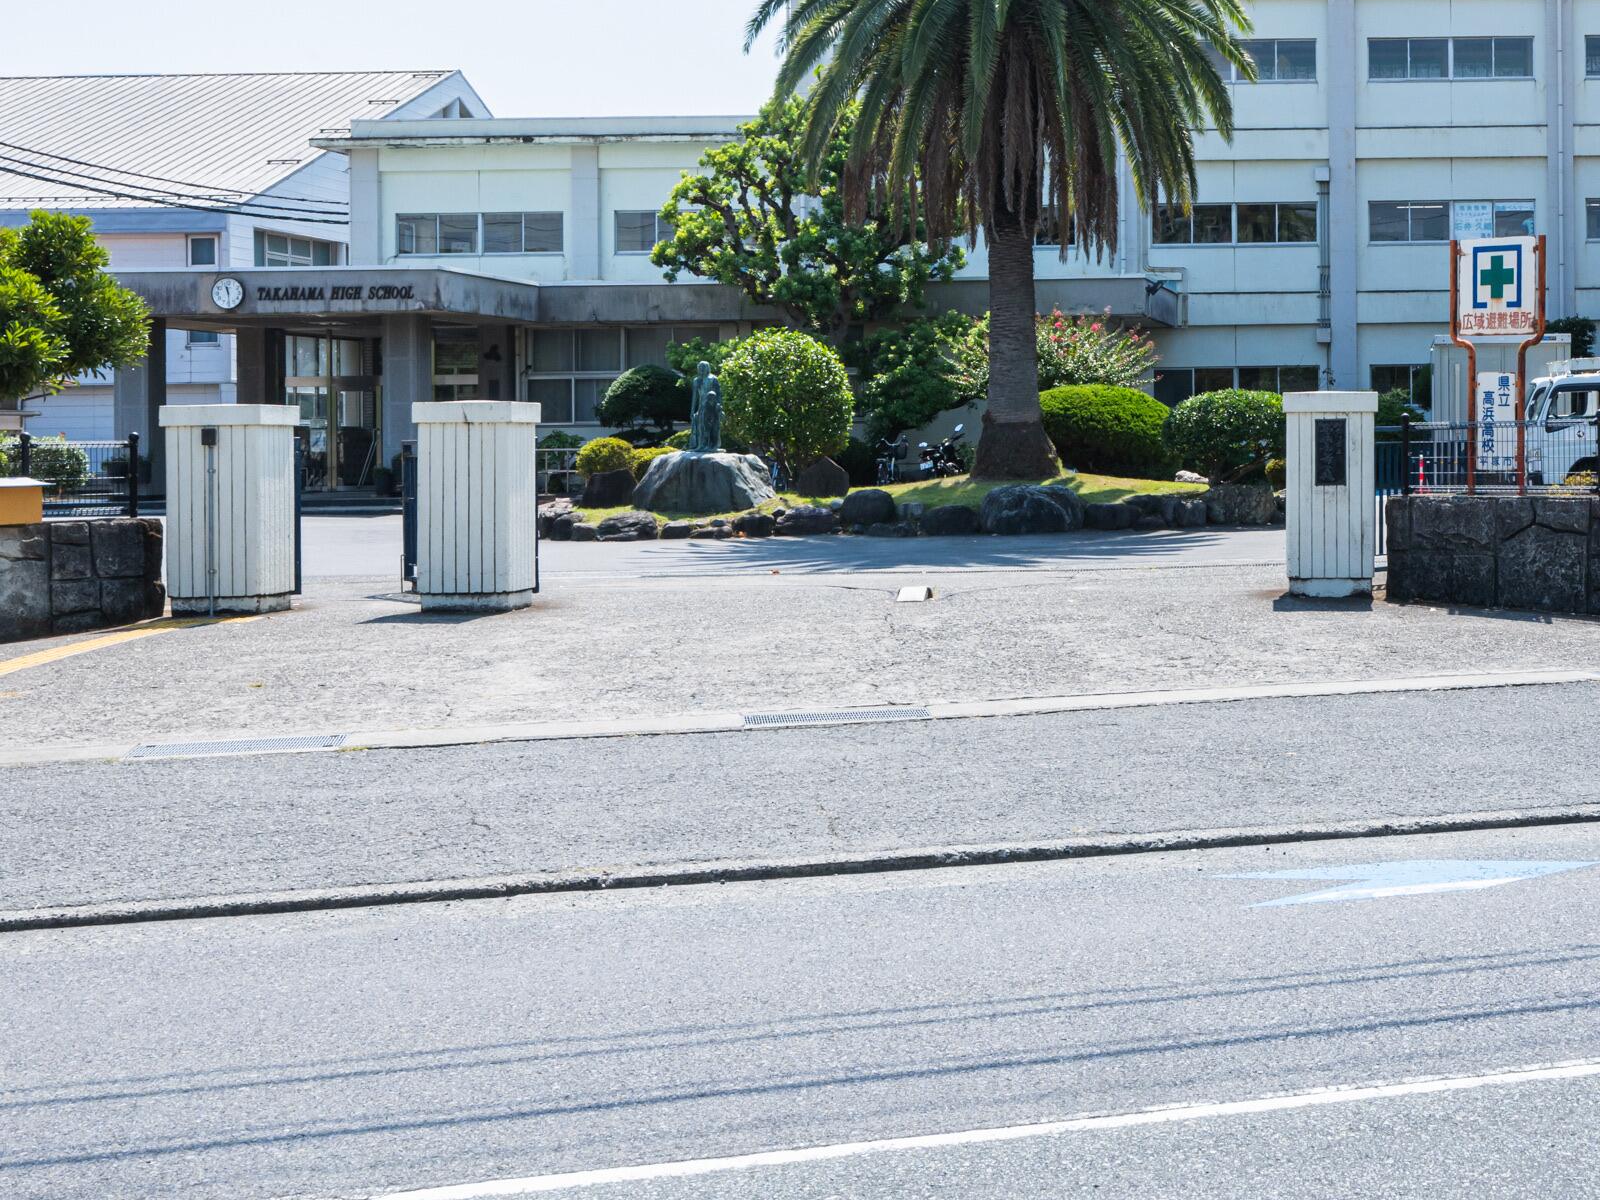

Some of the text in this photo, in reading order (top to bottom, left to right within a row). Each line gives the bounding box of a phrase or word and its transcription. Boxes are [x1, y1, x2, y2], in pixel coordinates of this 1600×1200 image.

[257, 286, 414, 300] TAKAHAMA HIGH SCHOOL
[1463, 312, 1531, 329] 広域避難場所
[1498, 375, 1510, 406] 県立
[1482, 391, 1495, 453] 高浜高校
